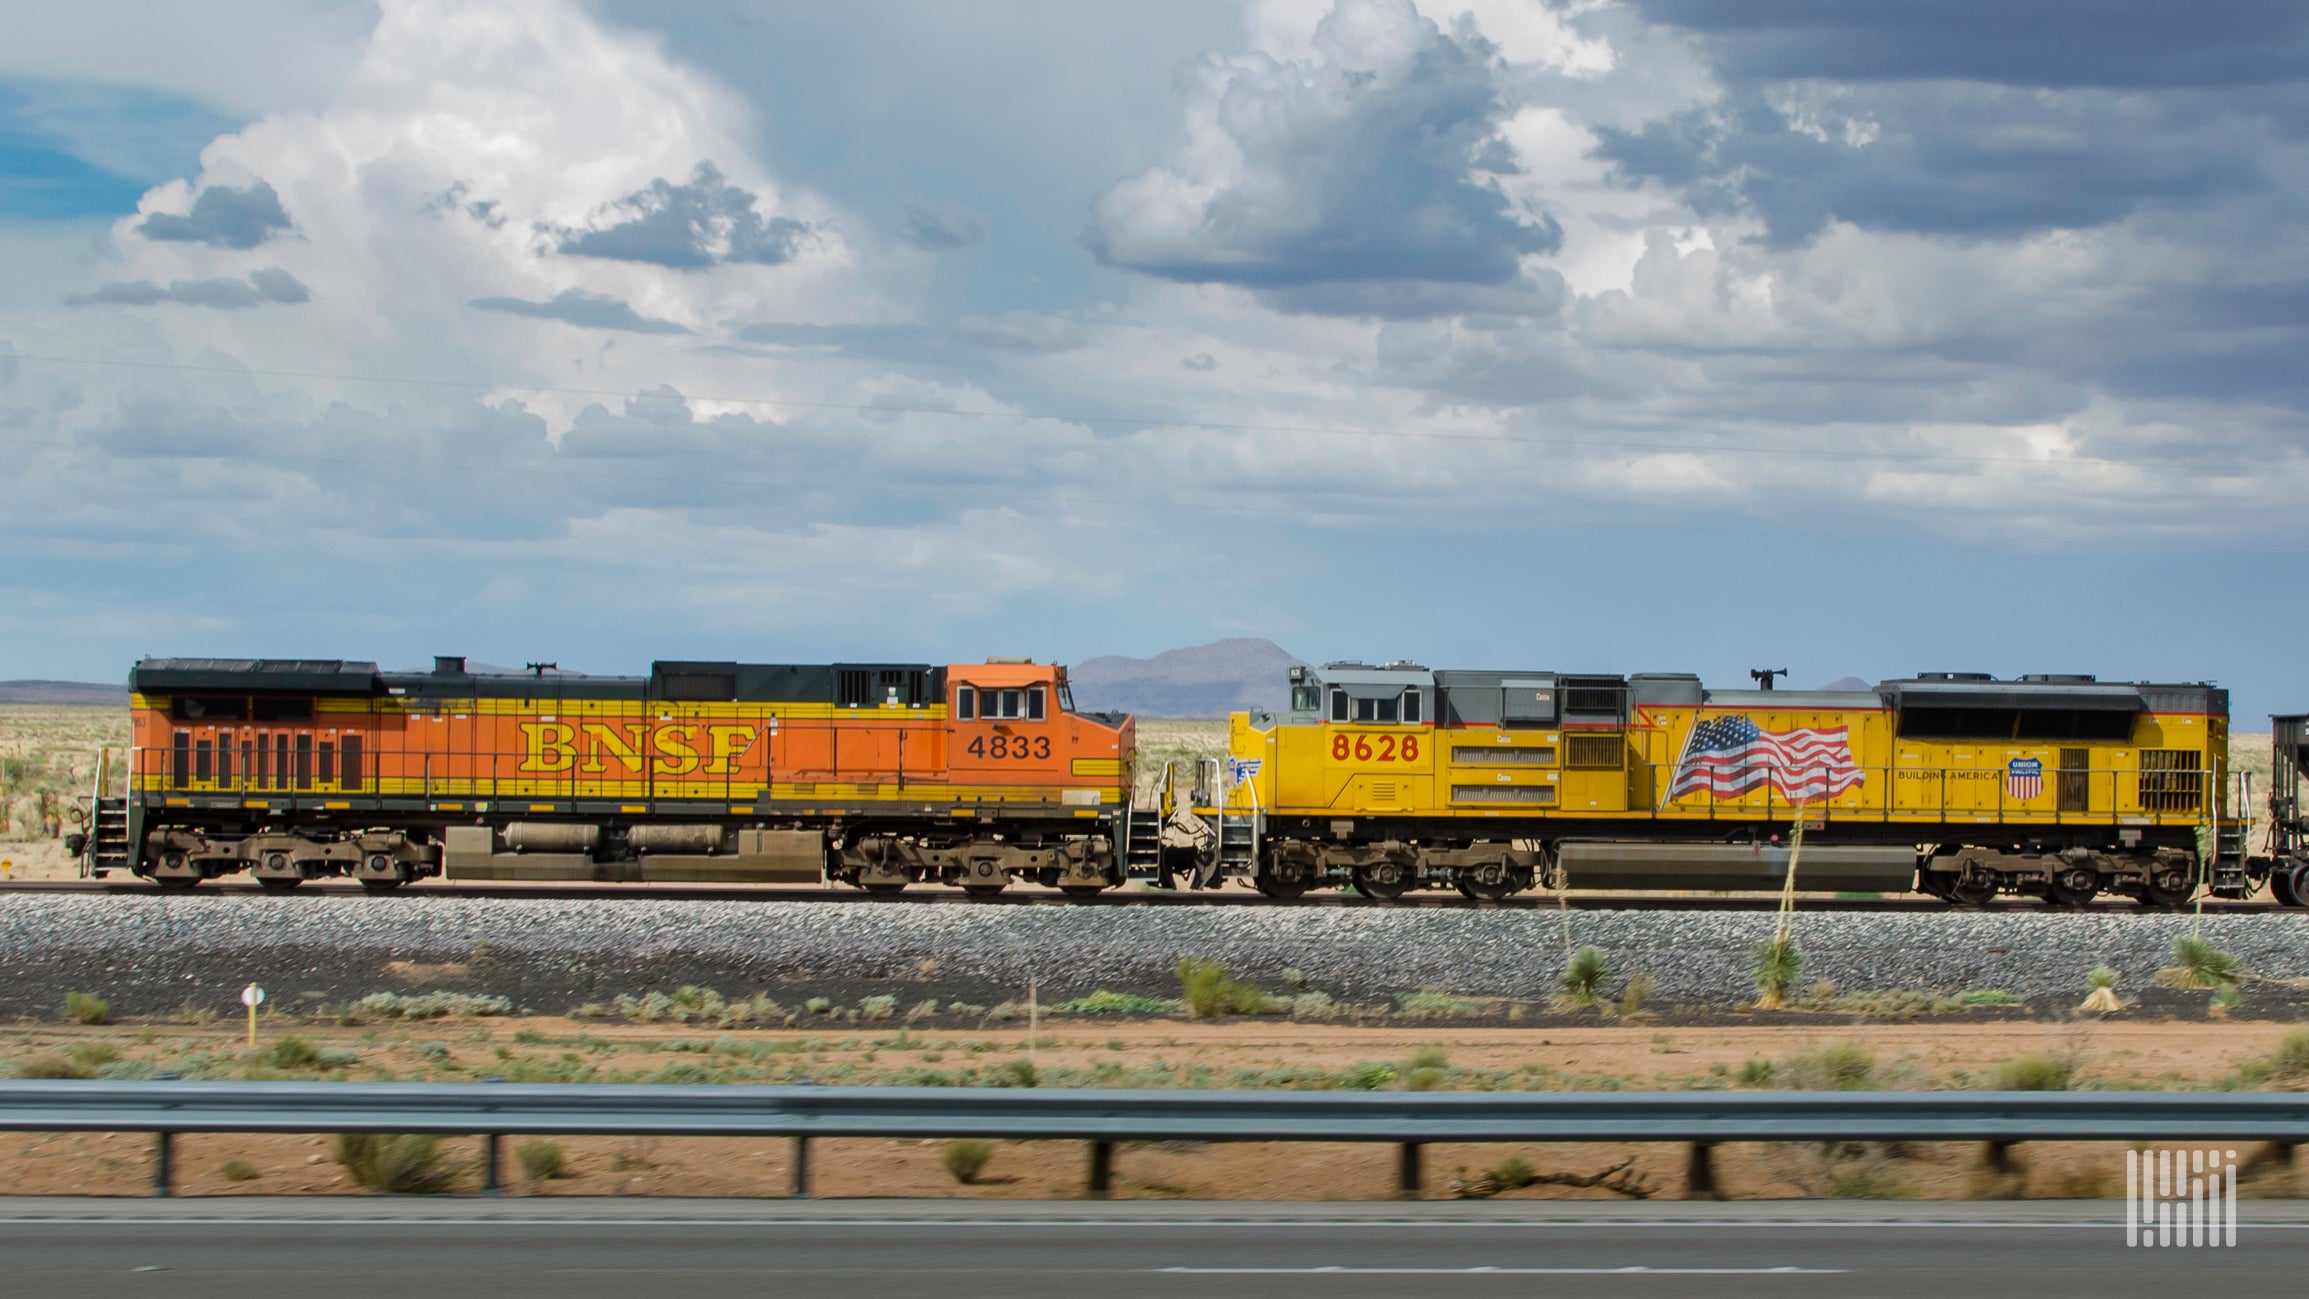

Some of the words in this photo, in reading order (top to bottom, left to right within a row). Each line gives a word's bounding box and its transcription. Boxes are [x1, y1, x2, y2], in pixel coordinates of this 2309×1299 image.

[519, 722, 757, 775] BNSF
[967, 735, 1051, 760] 4833
[1332, 734, 1419, 762] 8628
[1898, 771, 1946, 780] BUILDIN
[1949, 771, 1998, 780] AMERICA
